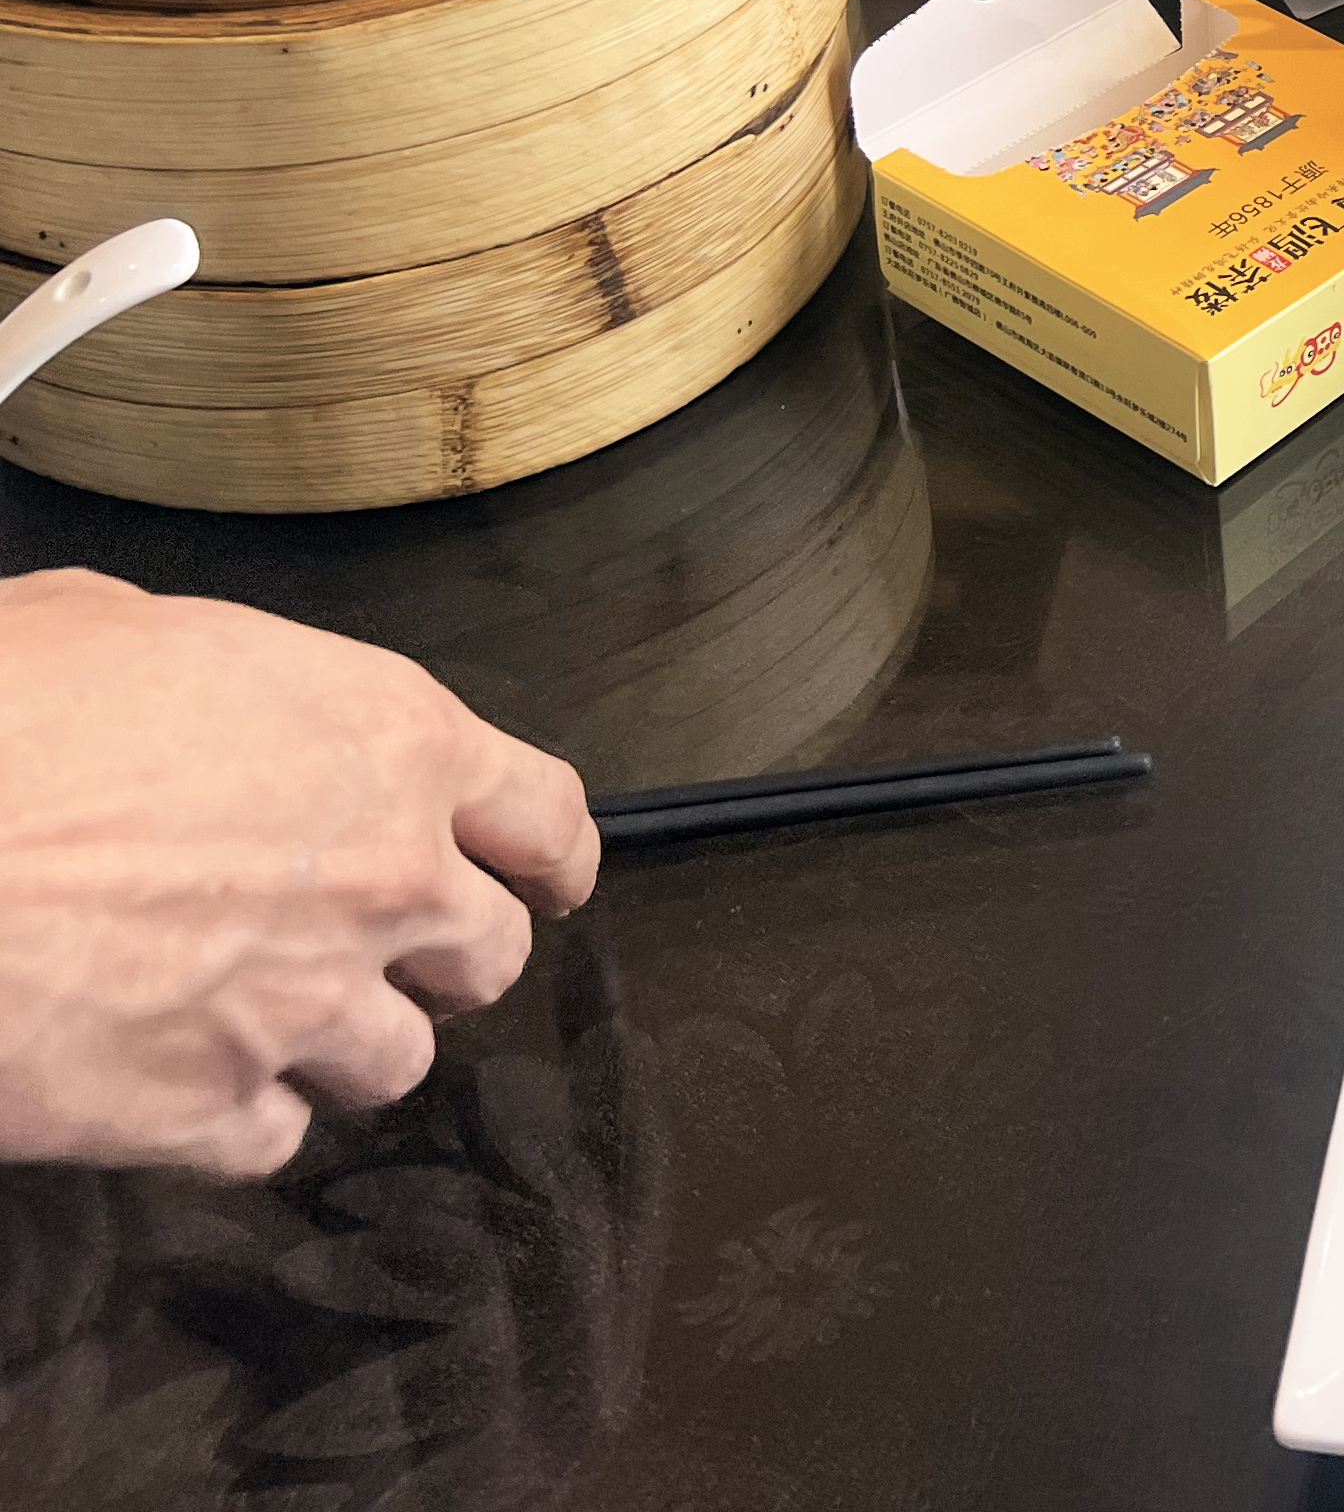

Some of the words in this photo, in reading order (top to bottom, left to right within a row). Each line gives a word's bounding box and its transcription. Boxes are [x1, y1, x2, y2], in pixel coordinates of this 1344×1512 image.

[1207, 159, 1329, 239] 源于1856年
[1184, 256, 1275, 317] 茶楼
